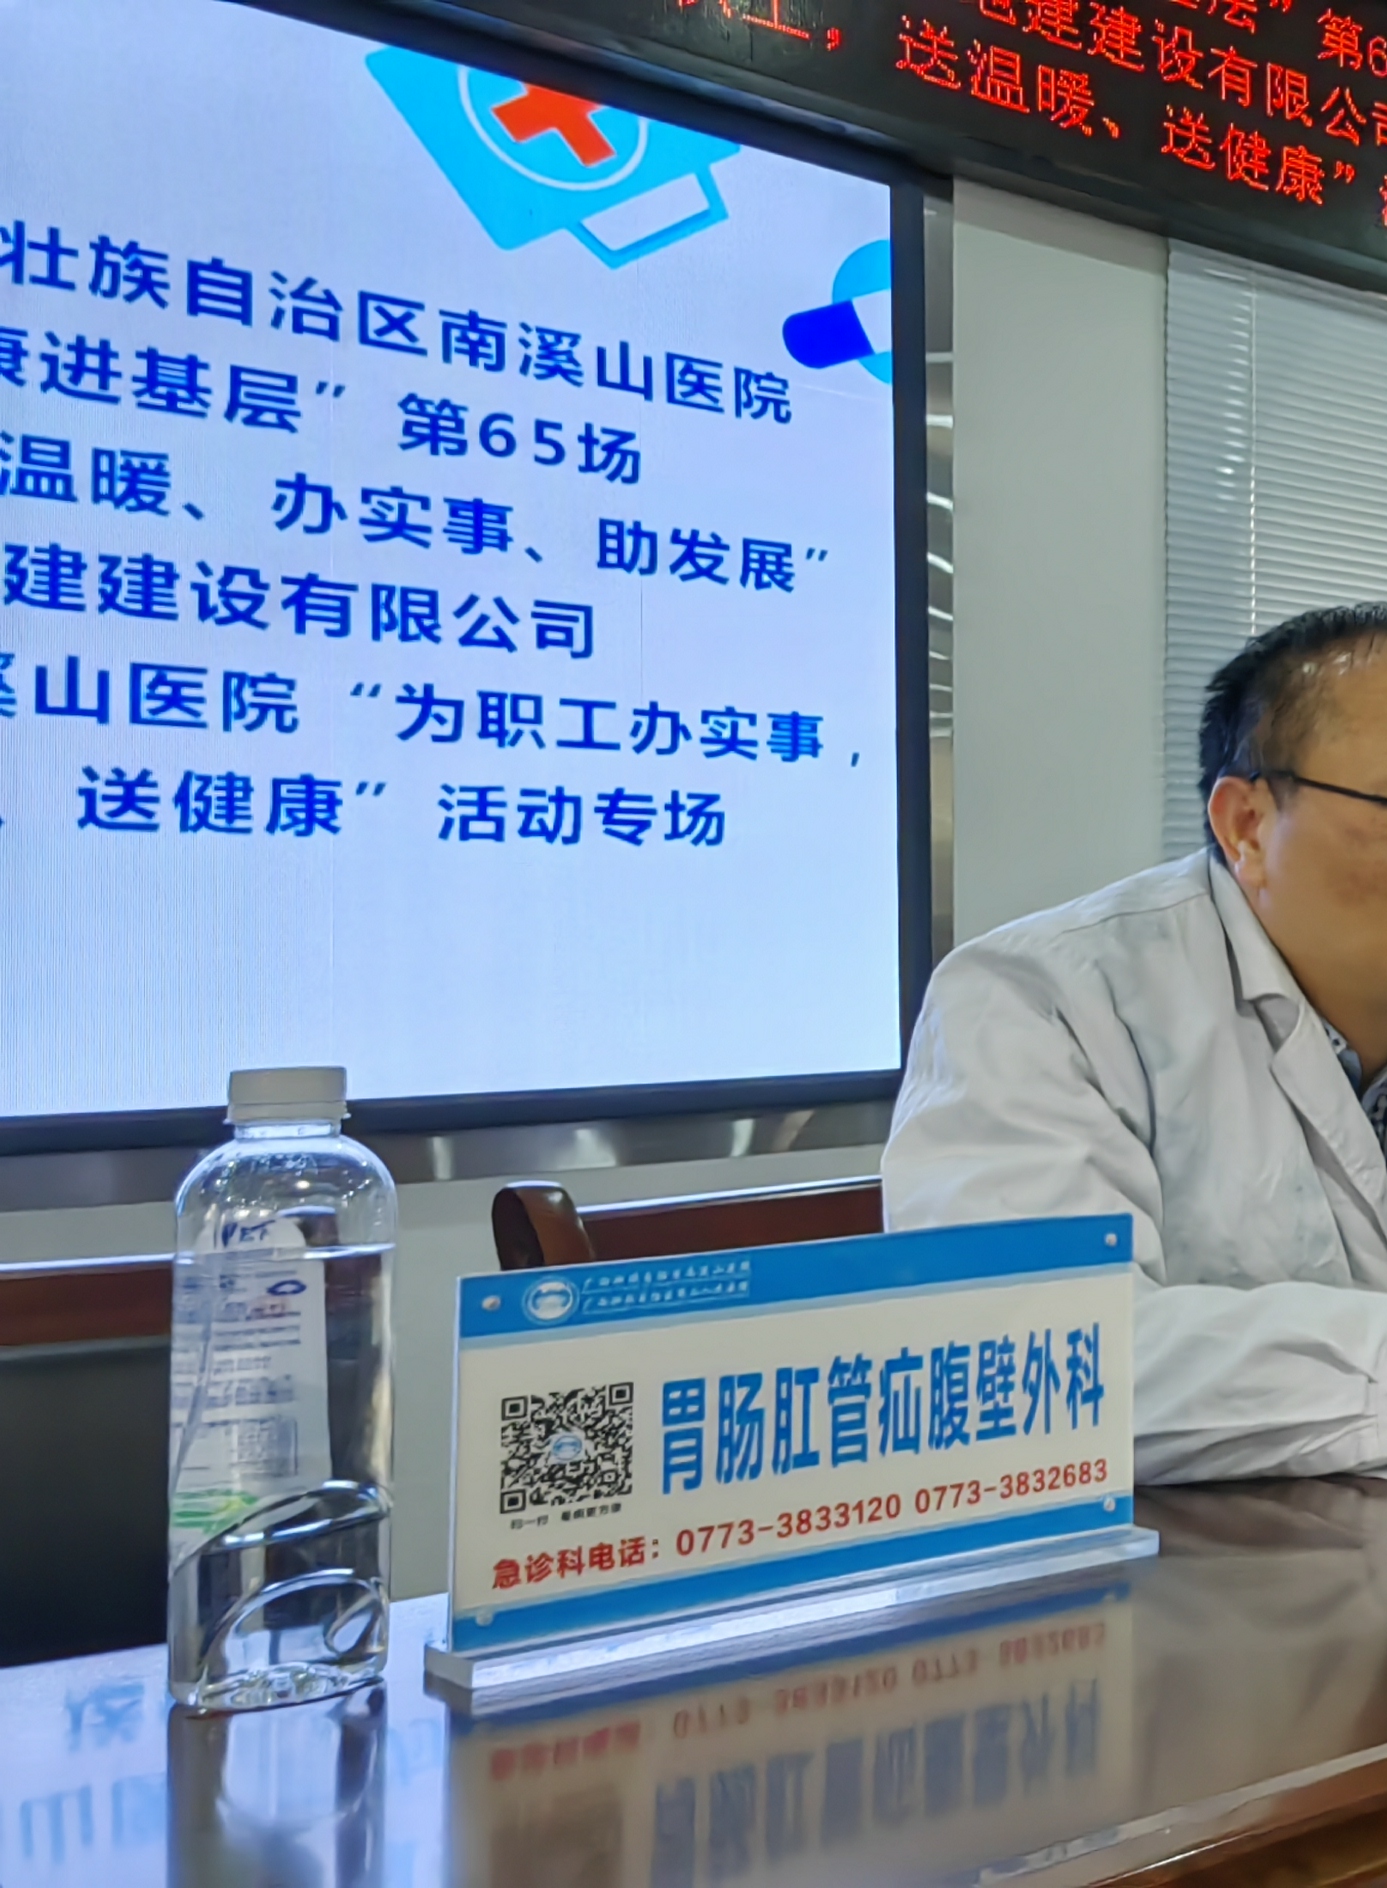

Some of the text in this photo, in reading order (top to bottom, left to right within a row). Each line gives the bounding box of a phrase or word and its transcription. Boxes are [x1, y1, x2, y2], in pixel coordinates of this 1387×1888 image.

[0, 220, 792, 424] 壮族自治区南溪山医院
[3, 543, 594, 659] 建建设有限公司
[661, 1323, 1105, 1494] 胃肠肛管疝腹壁外科
[915, 1458, 1108, 1514] 0773-3832683
